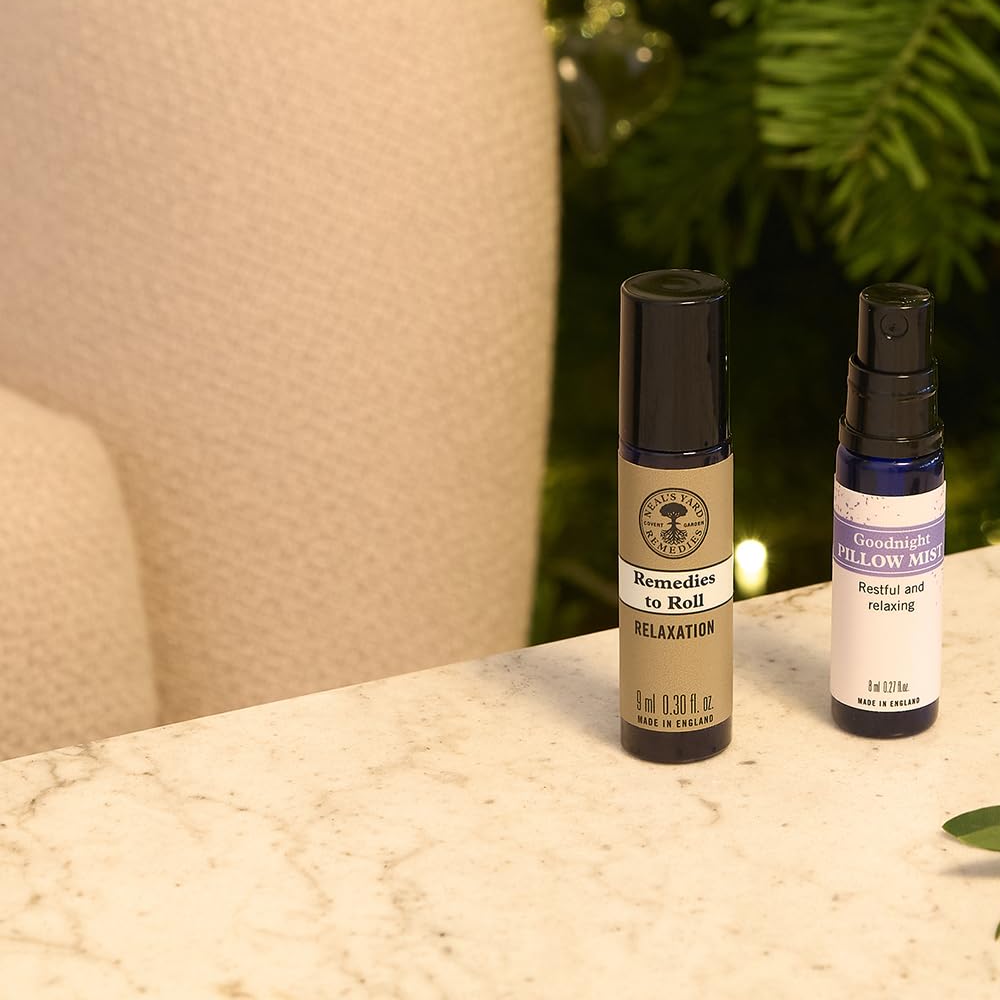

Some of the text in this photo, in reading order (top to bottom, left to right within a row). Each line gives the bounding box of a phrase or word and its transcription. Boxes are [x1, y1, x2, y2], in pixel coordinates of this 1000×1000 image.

[643, 493, 704, 519] NEAL'S YARD
[643, 520, 705, 528] COVENT GARDEN
[645, 529, 703, 554] REMEDIES
[853, 532, 931, 551] Goodnight
[837, 542, 943, 569] PILLOW MIST
[633, 570, 716, 589] Remedies
[858, 581, 925, 596] Restful and
[645, 593, 704, 610] to Roll
[868, 600, 916, 613] relaxing
[634, 619, 715, 640] RELAXATION
[636, 690, 714, 715] 9 ml 0.30 fl. oz.
[857, 697, 920, 708] MADE IN ENGLAND
[637, 714, 714, 728] MADE IN ENGLAND
